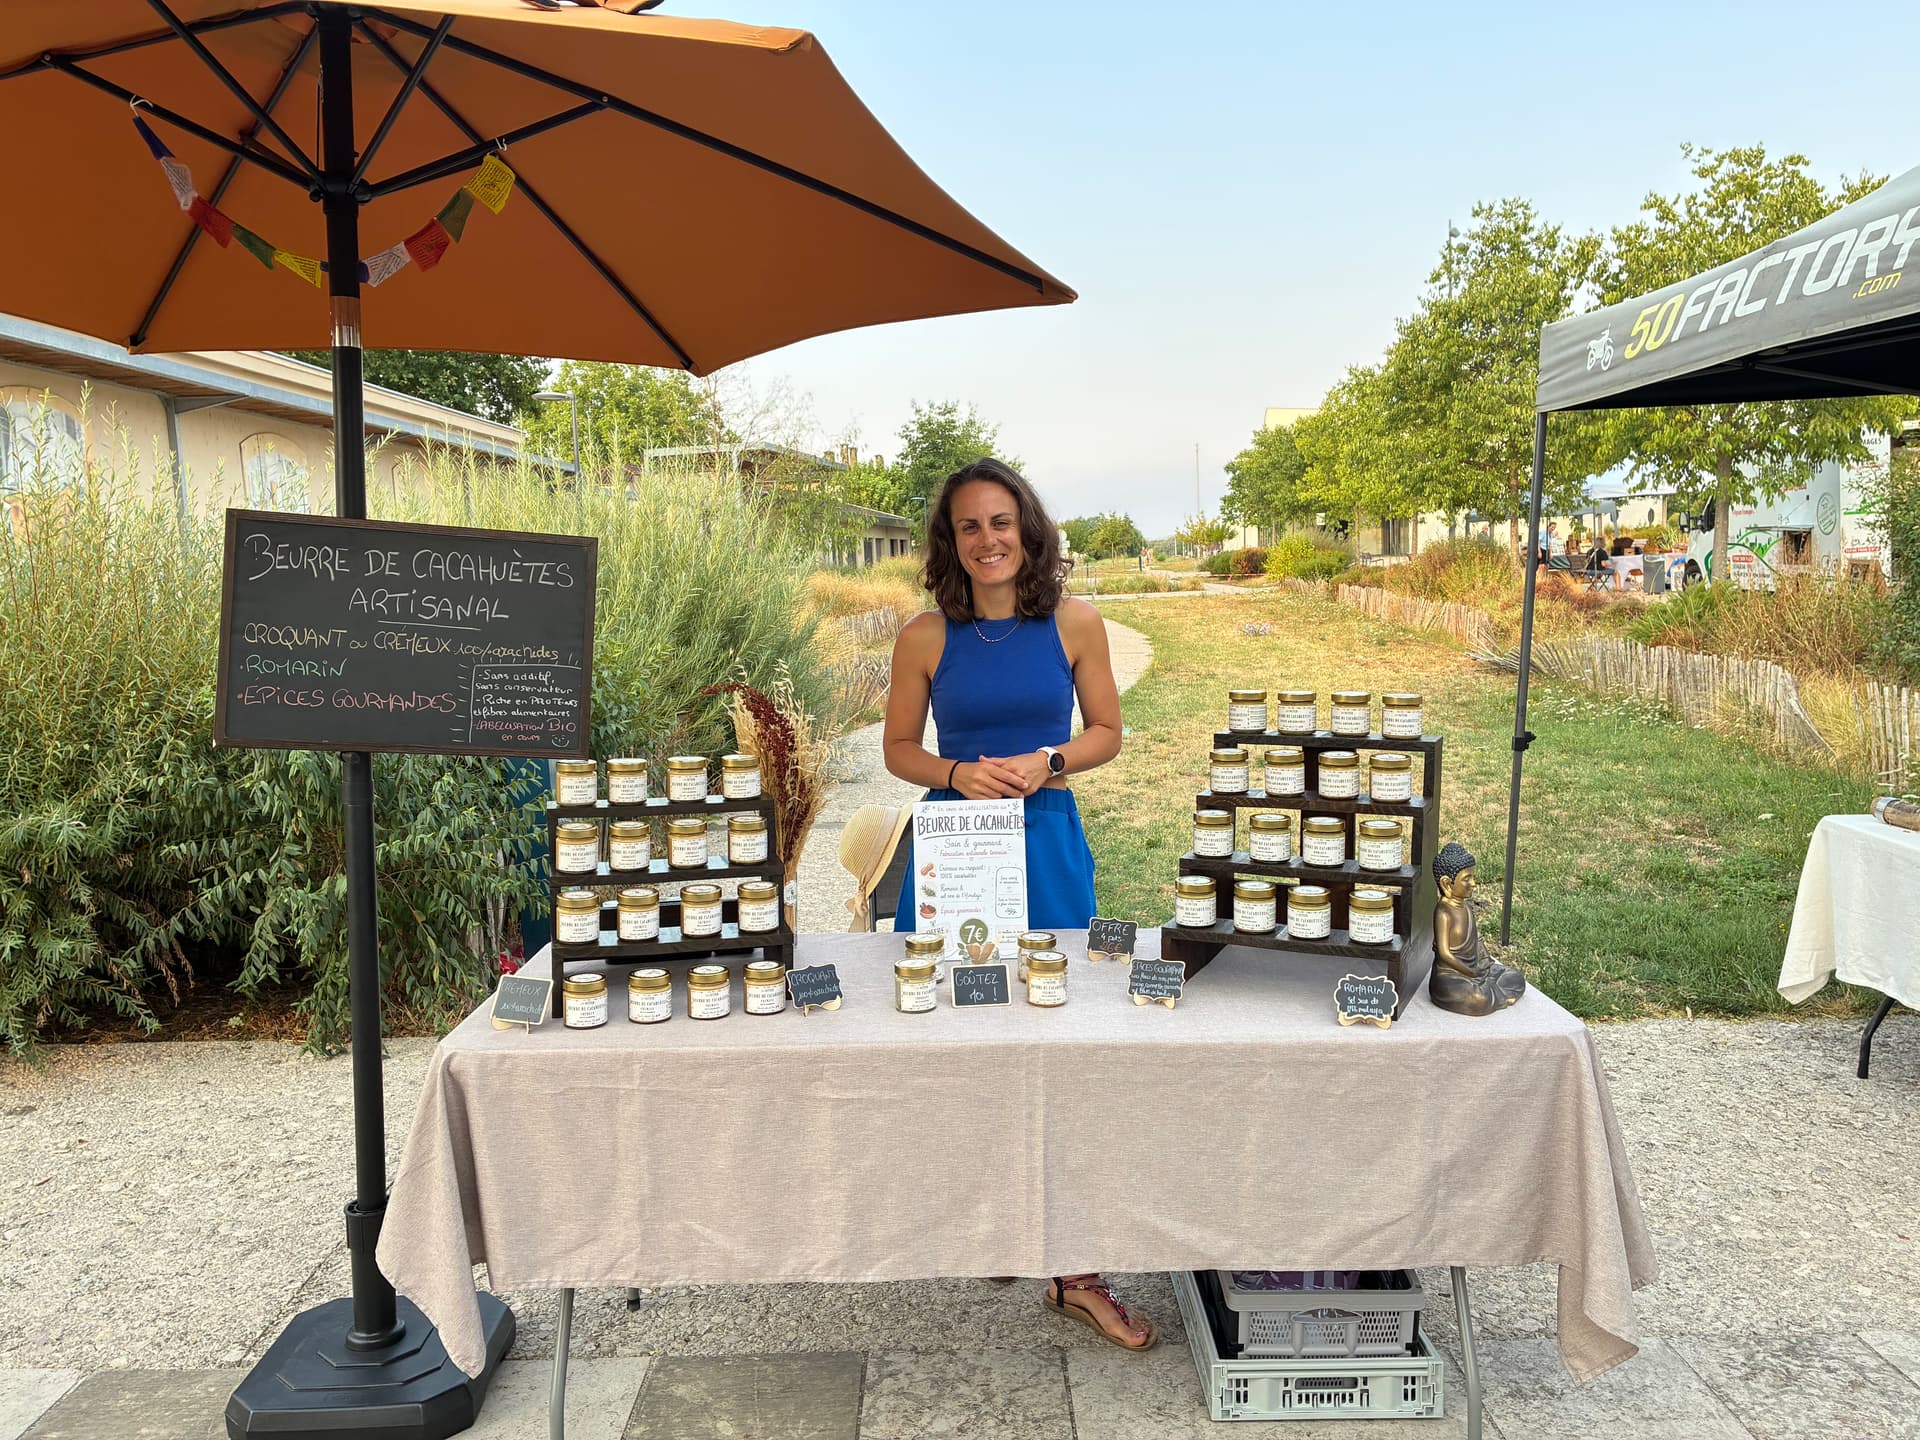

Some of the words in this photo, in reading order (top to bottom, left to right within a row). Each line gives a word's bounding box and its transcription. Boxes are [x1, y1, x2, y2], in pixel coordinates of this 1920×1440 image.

[1852, 271, 1902, 299] .com
[244, 533, 350, 581] BEURRE
[364, 550, 400, 576] DE
[412, 549, 574, 587] CACAHUÈTES
[244, 622, 348, 650] CROQUANT
[374, 625, 452, 656] CRÉMEUX
[332, 689, 457, 713] GOURMANDES
[482, 706, 508, 719] fibres
[511, 708, 570, 717] alimentaires
[546, 717, 577, 732] BIO
[917, 815, 956, 836] BEURRE
[960, 815, 971, 831] DE
[974, 811, 1025, 831] CACAHUÈTES
[944, 838, 962, 849] Sain
[964, 925, 984, 944] 7€
[1092, 920, 1130, 936] OFFRE
[955, 969, 999, 986] GOÛTEZ
